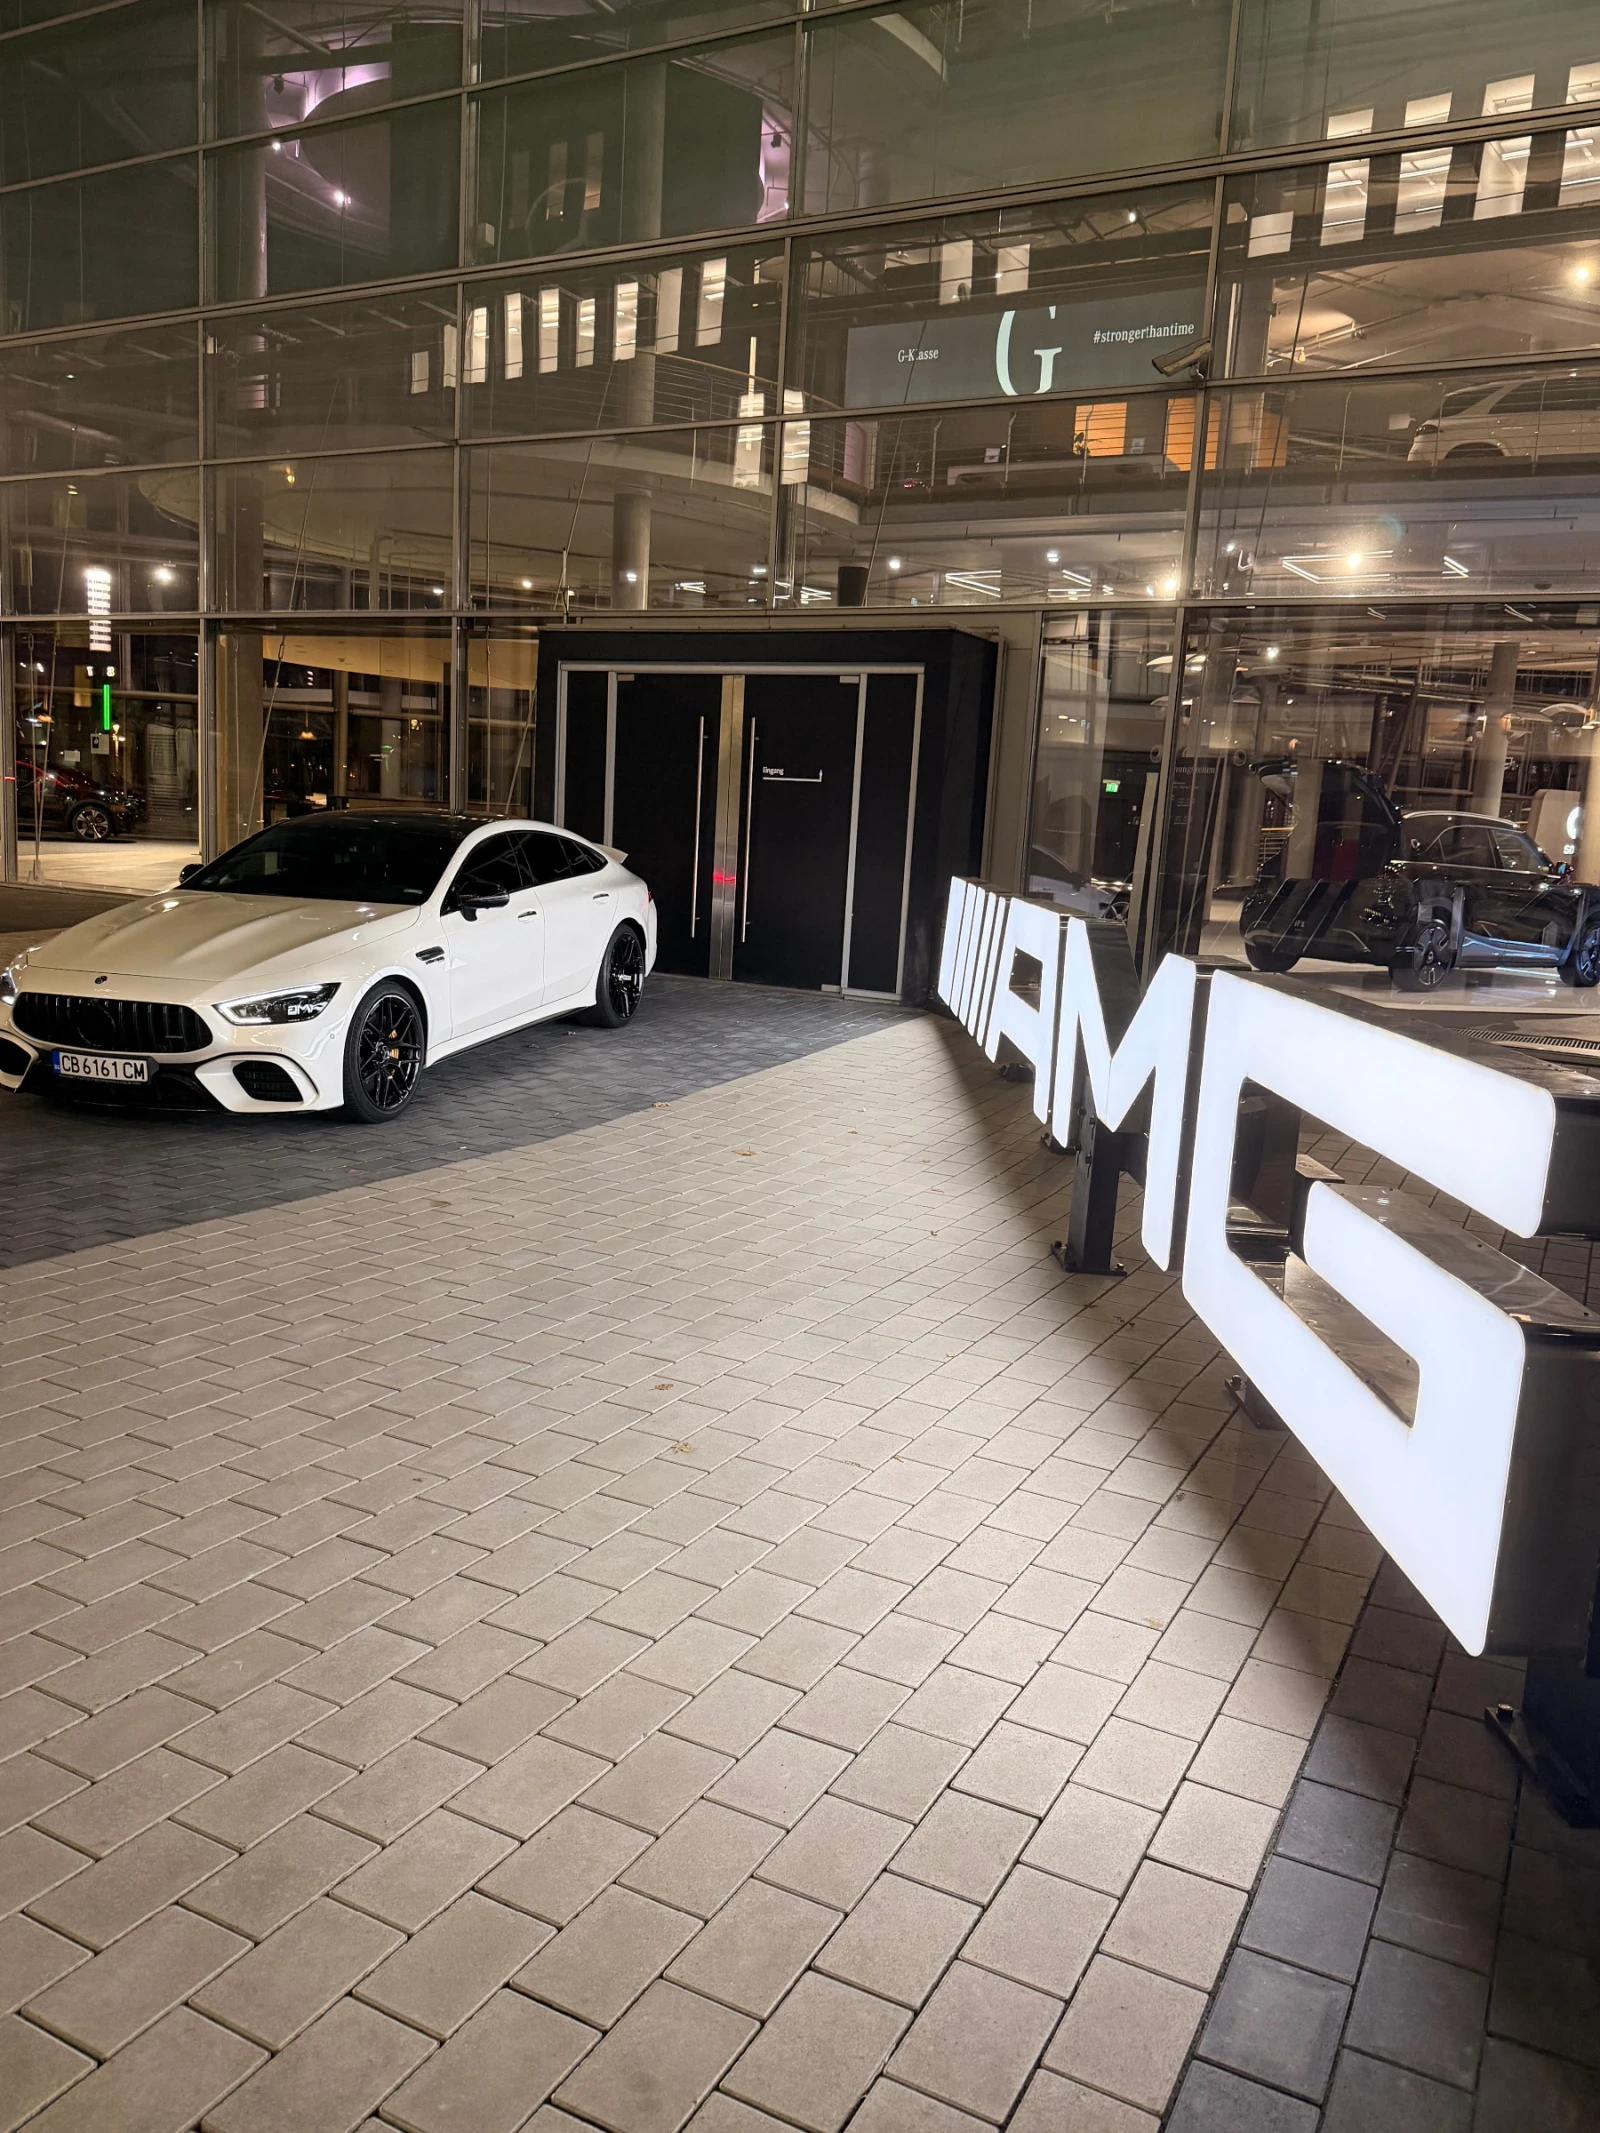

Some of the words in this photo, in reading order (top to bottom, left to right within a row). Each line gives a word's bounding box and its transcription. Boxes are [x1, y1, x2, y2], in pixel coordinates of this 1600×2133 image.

[996, 305, 1062, 396] G
[1093, 322, 1195, 343] #strongerthantime
[61, 1055, 80, 1074] CB
[83, 1058, 119, 1079] 6161
[123, 1062, 145, 1081] CM
[986, 897, 1556, 1657] AMG
